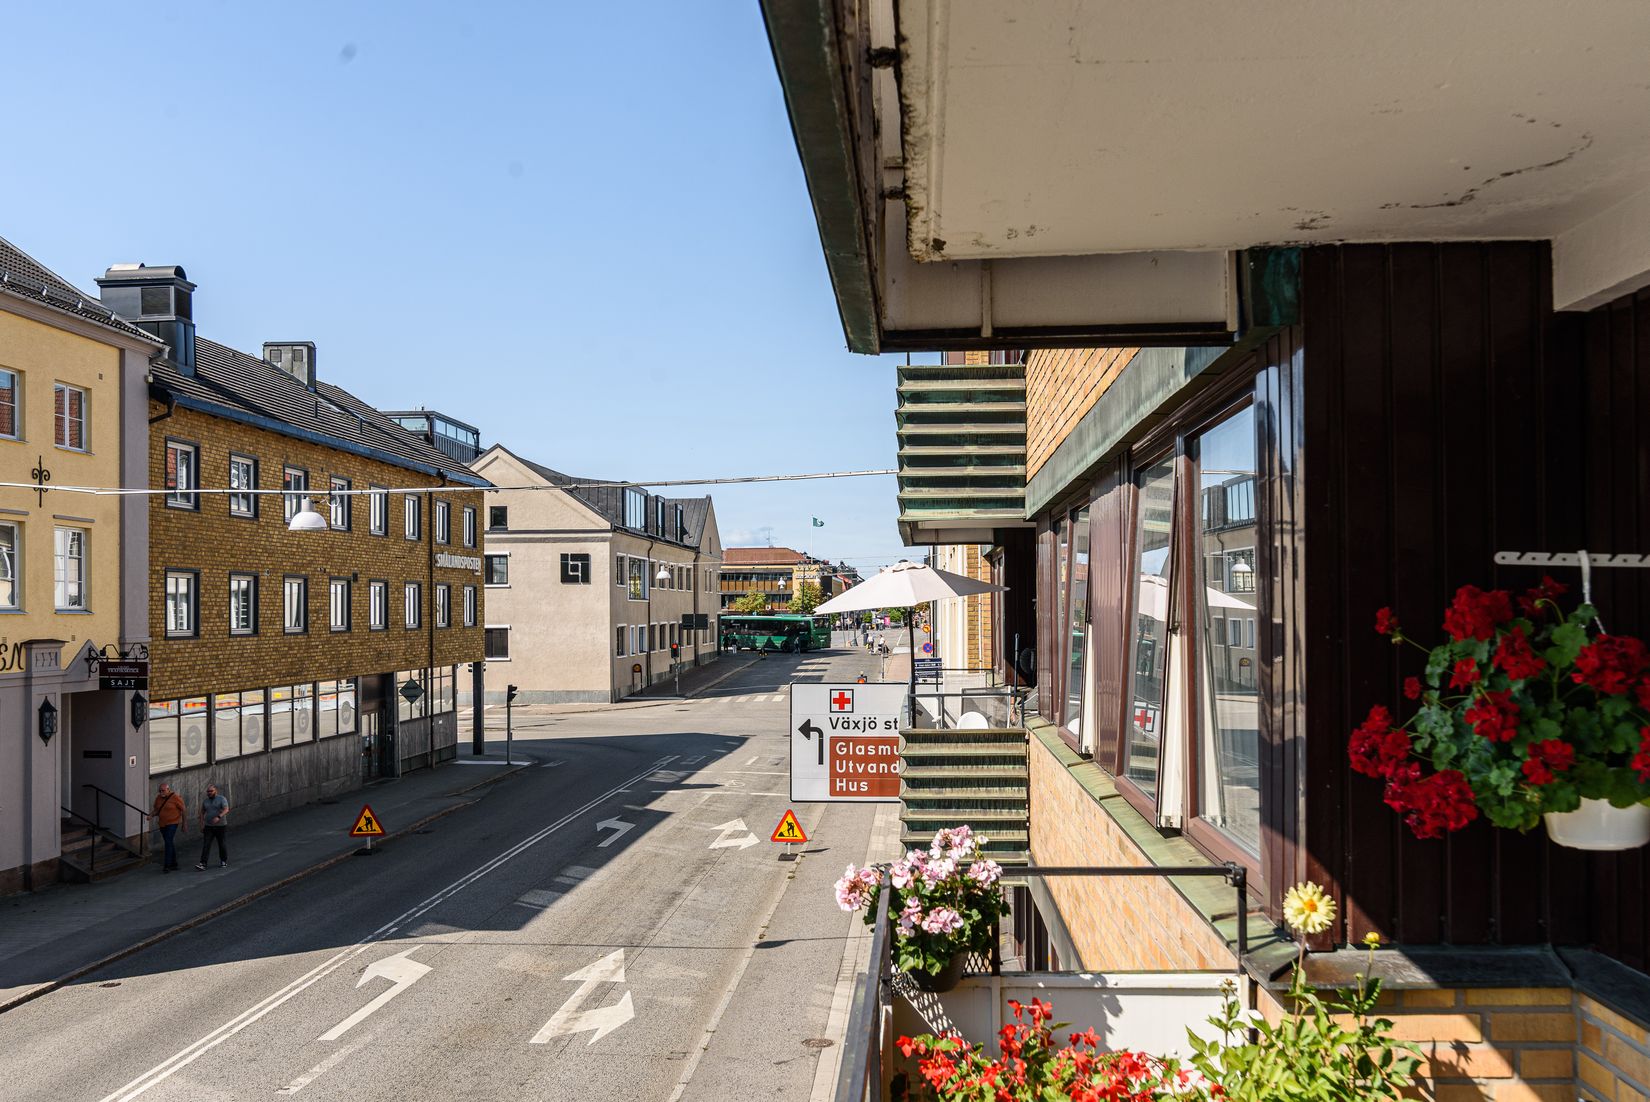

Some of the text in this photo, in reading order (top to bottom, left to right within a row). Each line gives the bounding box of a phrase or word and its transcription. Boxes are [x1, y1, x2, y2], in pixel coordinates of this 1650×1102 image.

[434, 551, 482, 571] SMÅLANDSPOSTEN
[829, 717, 899, 733] Växjö st
[835, 759, 899, 774] Utvand
[836, 778, 868, 792] Hus
